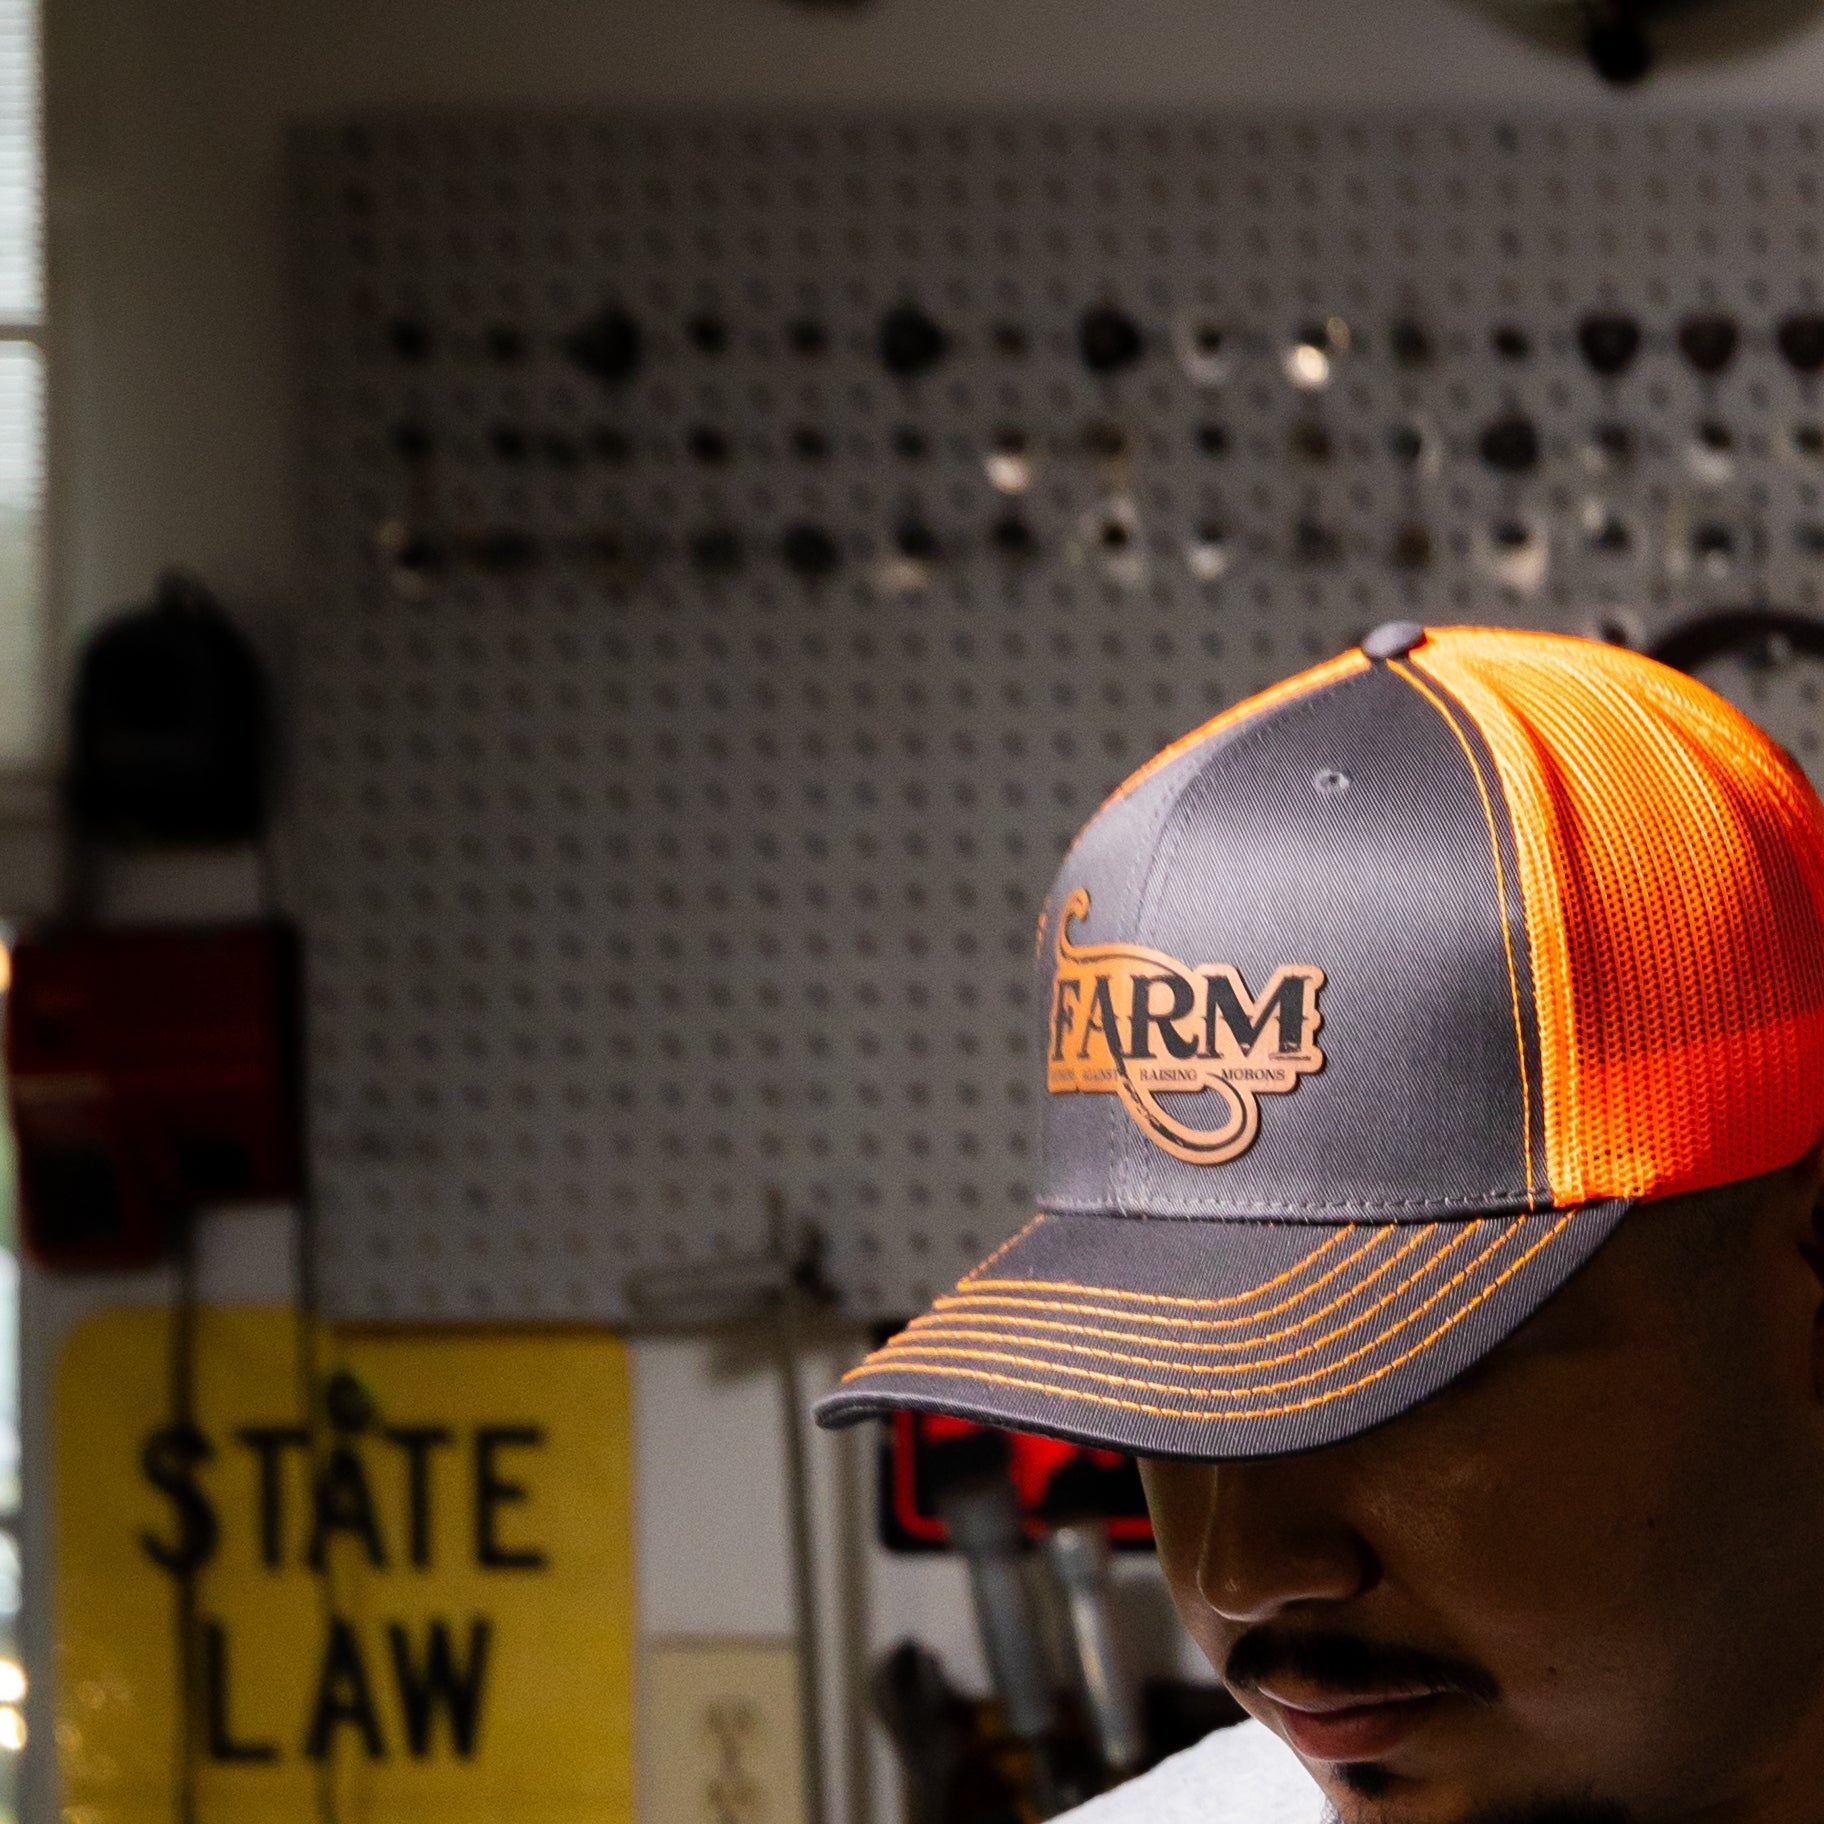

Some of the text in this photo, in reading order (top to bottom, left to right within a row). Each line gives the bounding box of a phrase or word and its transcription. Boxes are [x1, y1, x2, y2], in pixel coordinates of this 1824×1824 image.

[1051, 974, 1312, 1062] FARM
[1139, 1067, 1198, 1082] RAISING
[1221, 1067, 1286, 1082] MORONS
[139, 1423, 548, 1574] STATE
[203, 1618, 490, 1764] LAW
